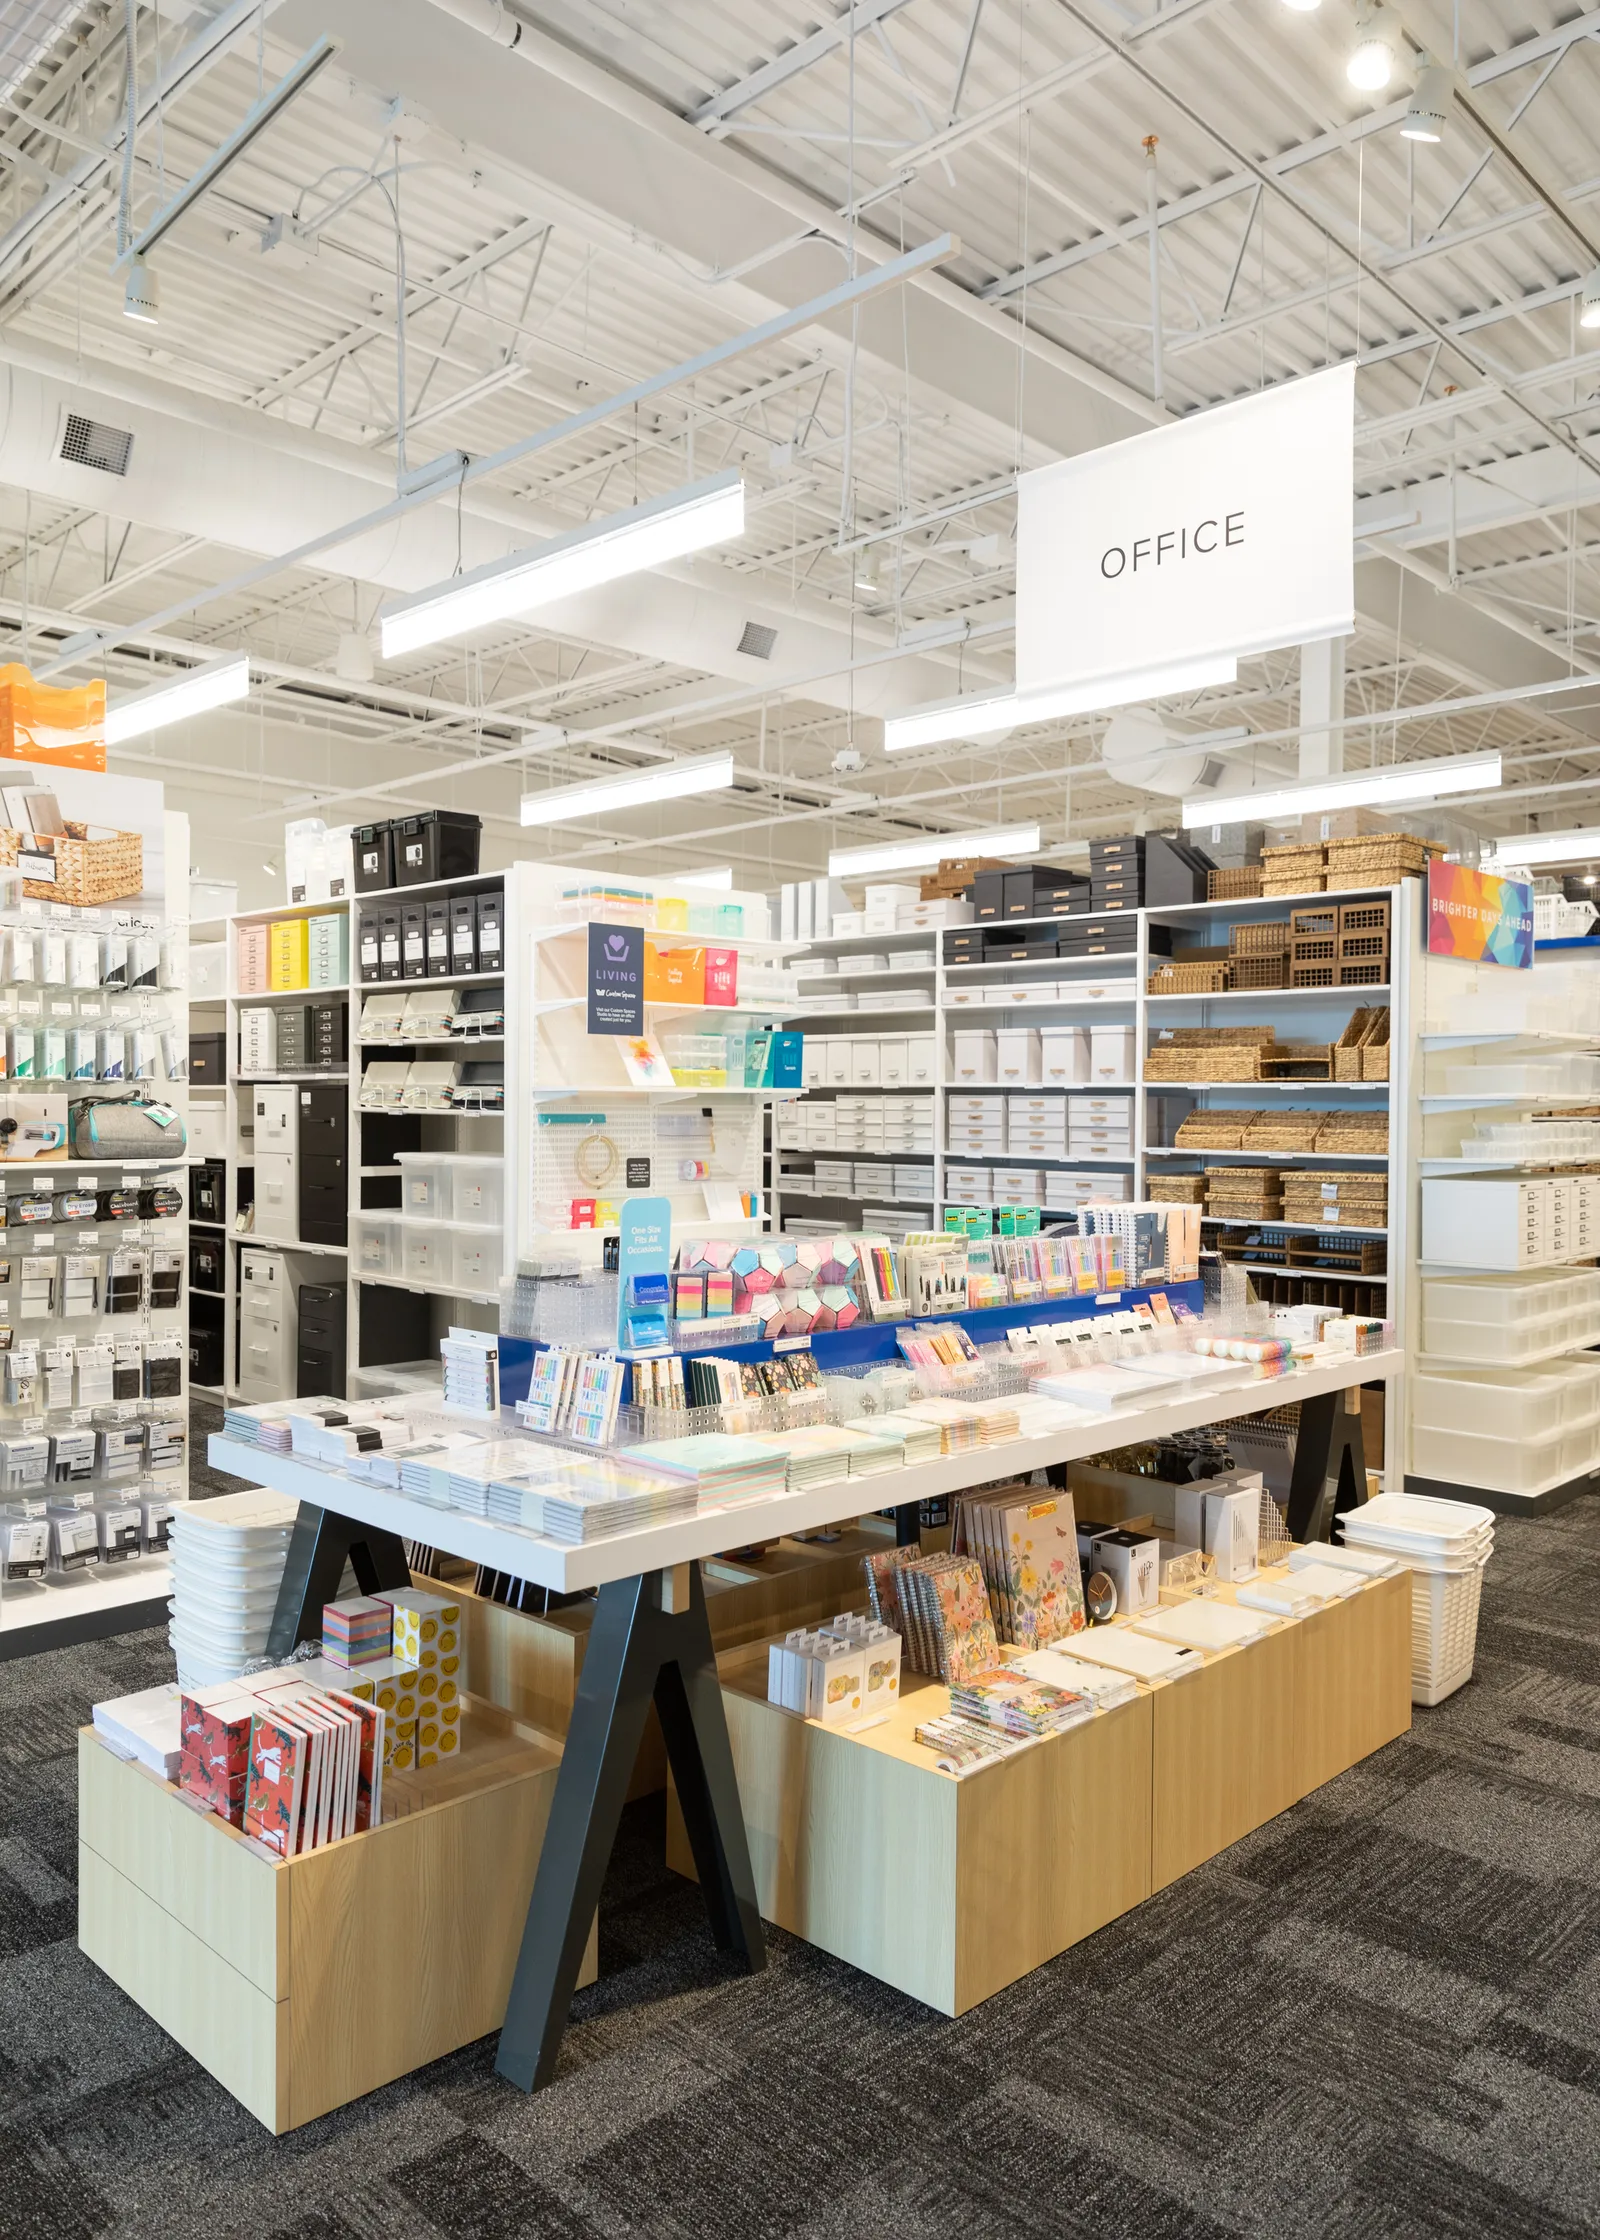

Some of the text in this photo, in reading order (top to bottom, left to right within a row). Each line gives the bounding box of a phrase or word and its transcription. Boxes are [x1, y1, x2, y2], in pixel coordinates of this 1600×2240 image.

[1101, 511, 1245, 579] OFFICE
[1432, 898, 1532, 933] BRIGHTER DAYS AHEAD
[596, 969, 637, 982] LIVING
[110, 1200, 139, 1209] Chalkboard
[154, 1198, 182, 1207] Chalkboard
[34, 1205, 50, 1213] Erase
[631, 1225, 662, 1235] One Size
[634, 1234, 658, 1245] Fits All
[627, 1244, 664, 1255] Occasions.
